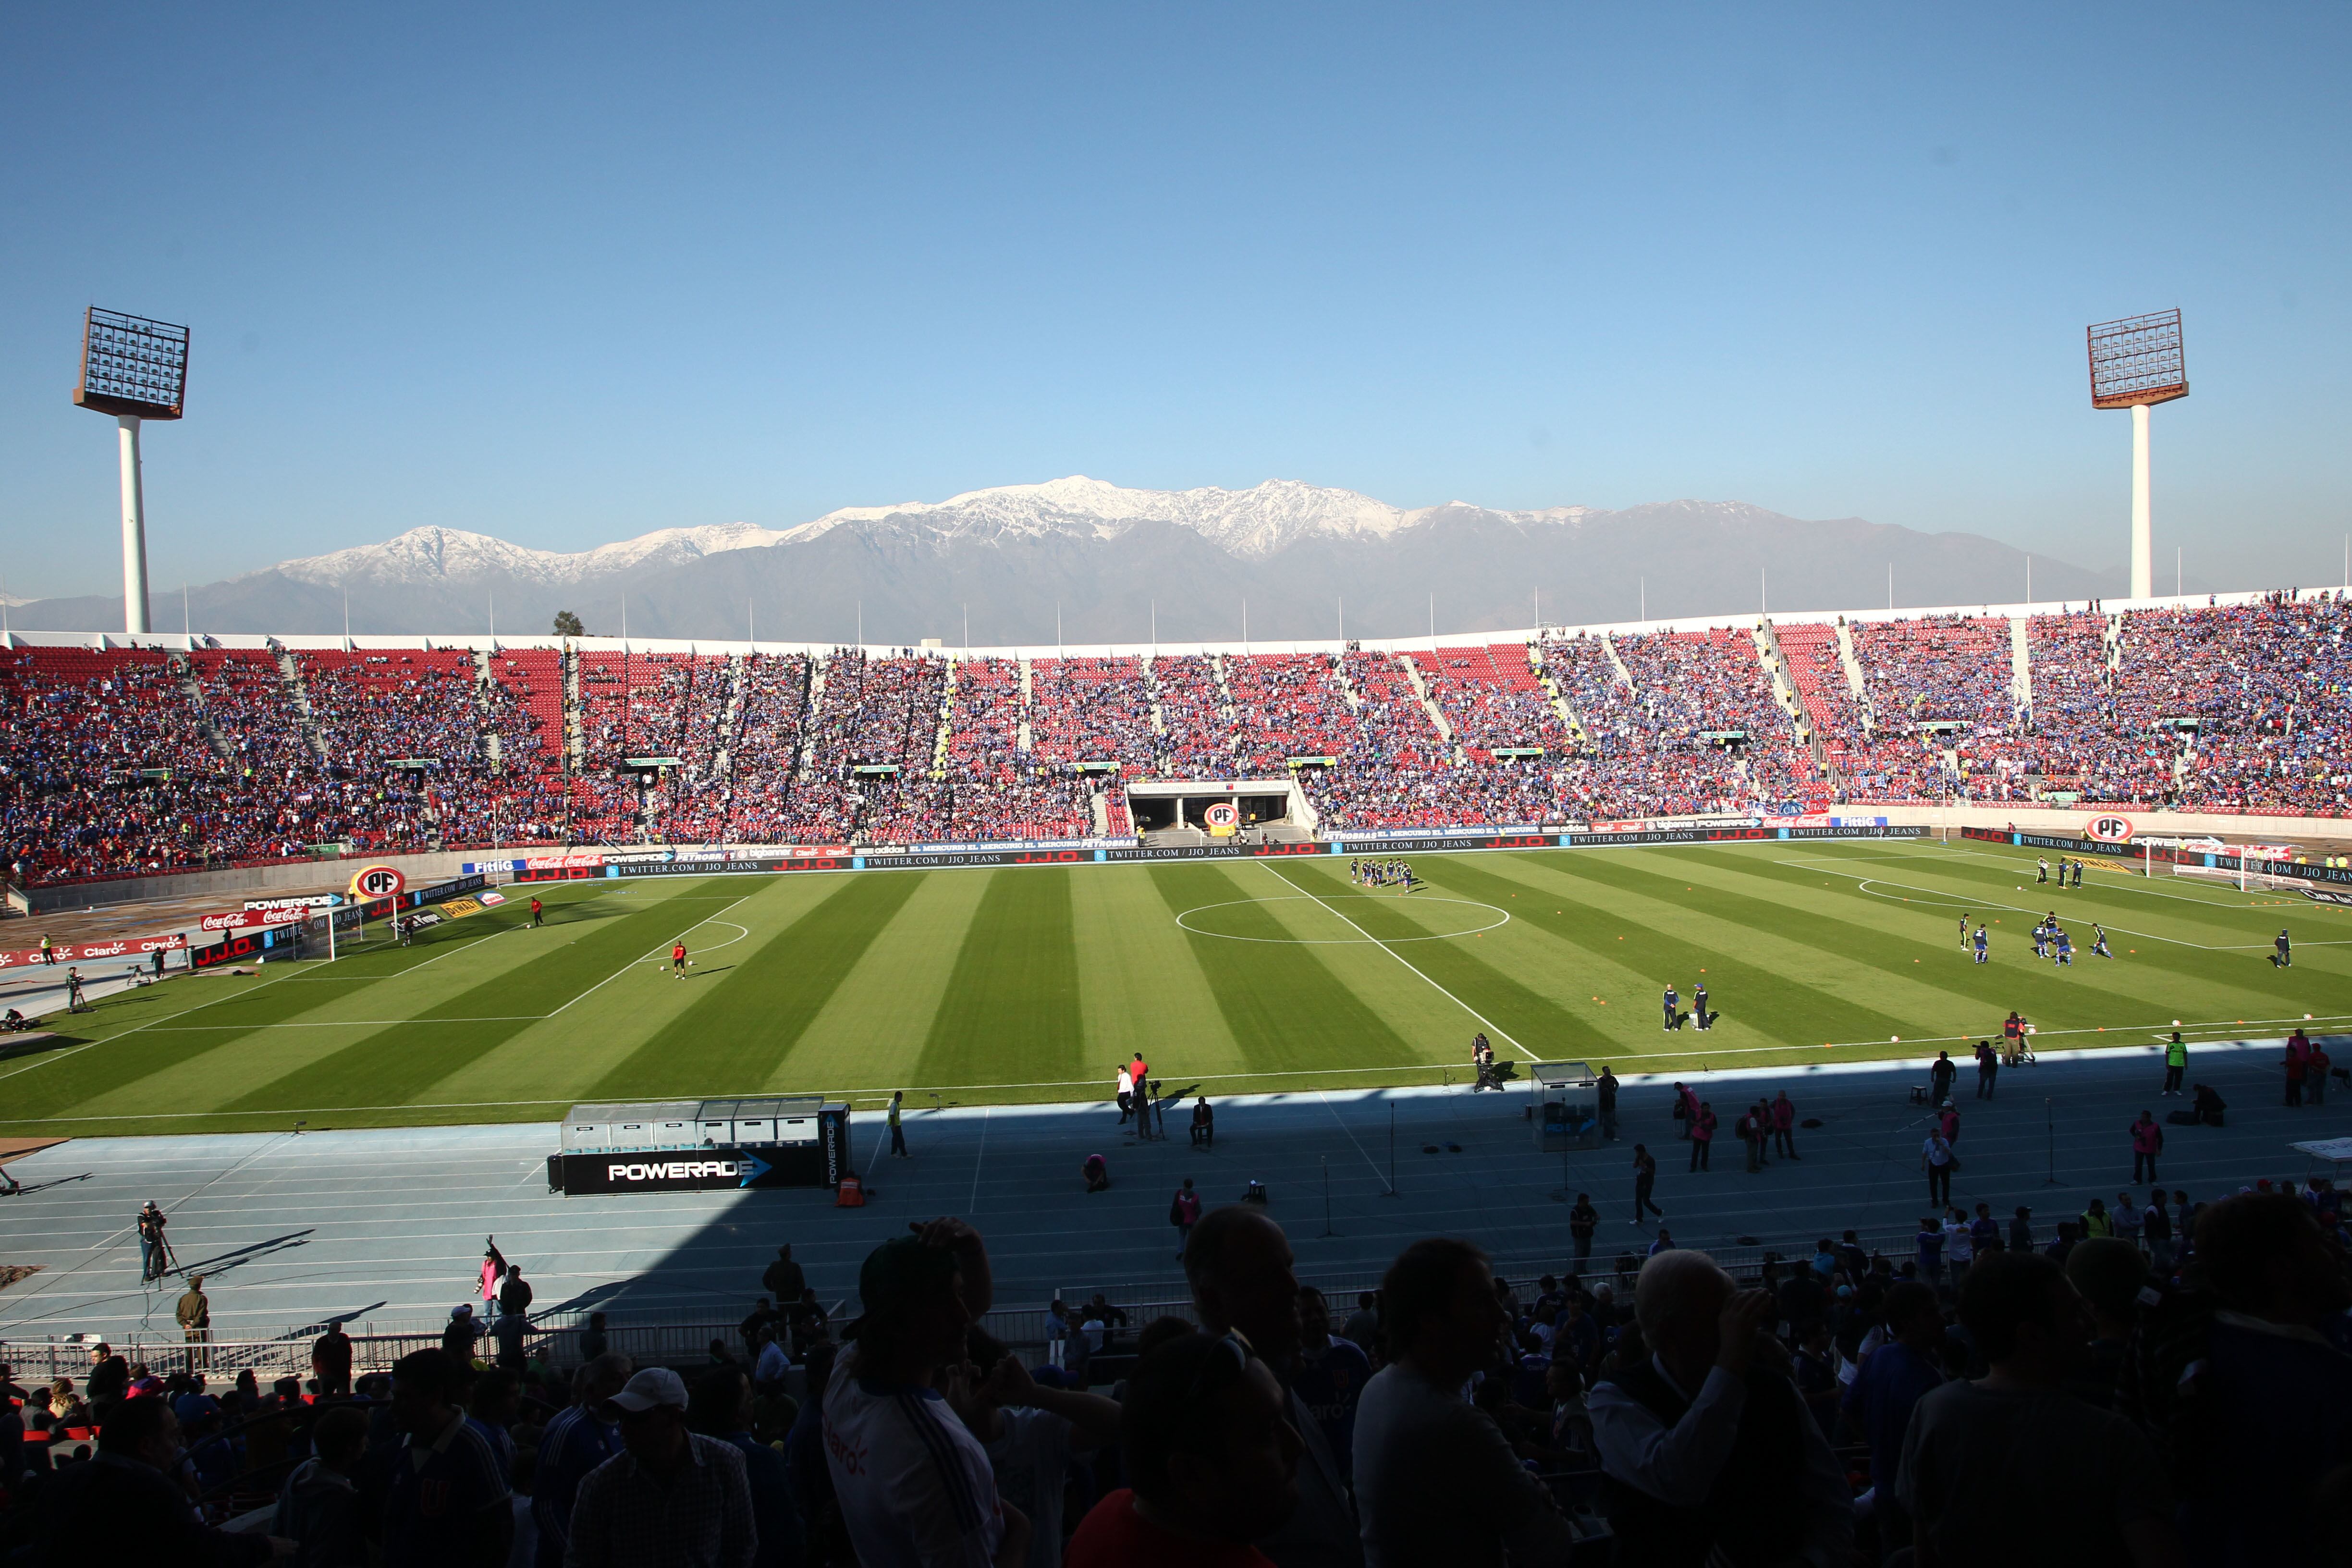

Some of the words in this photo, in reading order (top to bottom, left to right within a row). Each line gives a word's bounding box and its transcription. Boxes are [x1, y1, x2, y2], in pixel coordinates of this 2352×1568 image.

[1214, 808, 1230, 822] PF
[1763, 818, 1794, 827] Coca-Cola
[1796, 817, 1829, 826] Coca-Cola
[1840, 817, 1876, 827] FittiG
[1657, 821, 1695, 830] bigbanner
[1698, 819, 1756, 827] POWERADE
[2098, 819, 2122, 836] PF
[1323, 832, 1377, 840] PETROBRAS
[1486, 836, 1550, 847] J.J.O.
[1573, 834, 1638, 844] TWITTER.COM
[1647, 833, 1694, 842] JJO_JEANS
[1708, 829, 1769, 840] J.J.O.
[1792, 828, 1859, 836] TWITTER.COM
[1869, 827, 1921, 836] JJO_JEANS
[875, 845, 906, 854] adidas
[1081, 839, 1138, 848] PETROBRAS
[1254, 844, 1321, 855] J.J.O.
[1345, 842, 1413, 851] TWITTER.COM
[1422, 840, 1471, 849] JJO_JEANS
[2023, 836, 2073, 848] TWITTER.COM
[2080, 842, 2121, 853] JJO_JEANS
[602, 853, 666, 864] POWERADE
[749, 849, 791, 858] bigbanner
[1015, 851, 1084, 863] J.J.O.
[1109, 848, 1179, 858] TWITTER.COM
[1188, 847, 1239, 857] JJO_JEANS
[528, 857, 564, 870] Coca-Cola
[565, 855, 600, 867] Coca-Cola
[622, 863, 695, 874] TWITTER.COM
[705, 862, 758, 872] JJO_JEANS
[773, 859, 842, 870] J.J.O.
[867, 856, 938, 866] TWITTER.COM
[948, 855, 1001, 864] JJO_JEANS
[368, 872, 394, 893] PF
[422, 884, 455, 900] TWITTER.COM
[244, 896, 332, 911] POWERADE
[203, 913, 246, 930] Coca-Cola
[263, 907, 304, 923] Coca-Cola
[197, 938, 256, 966] J.J.O.
[334, 908, 364, 925] JO_JEANS
[85, 944, 123, 957] Claro
[141, 939, 178, 951] Claro
[827, 1121, 838, 1184] POWERADE
[609, 1160, 754, 1181] POWERADE
